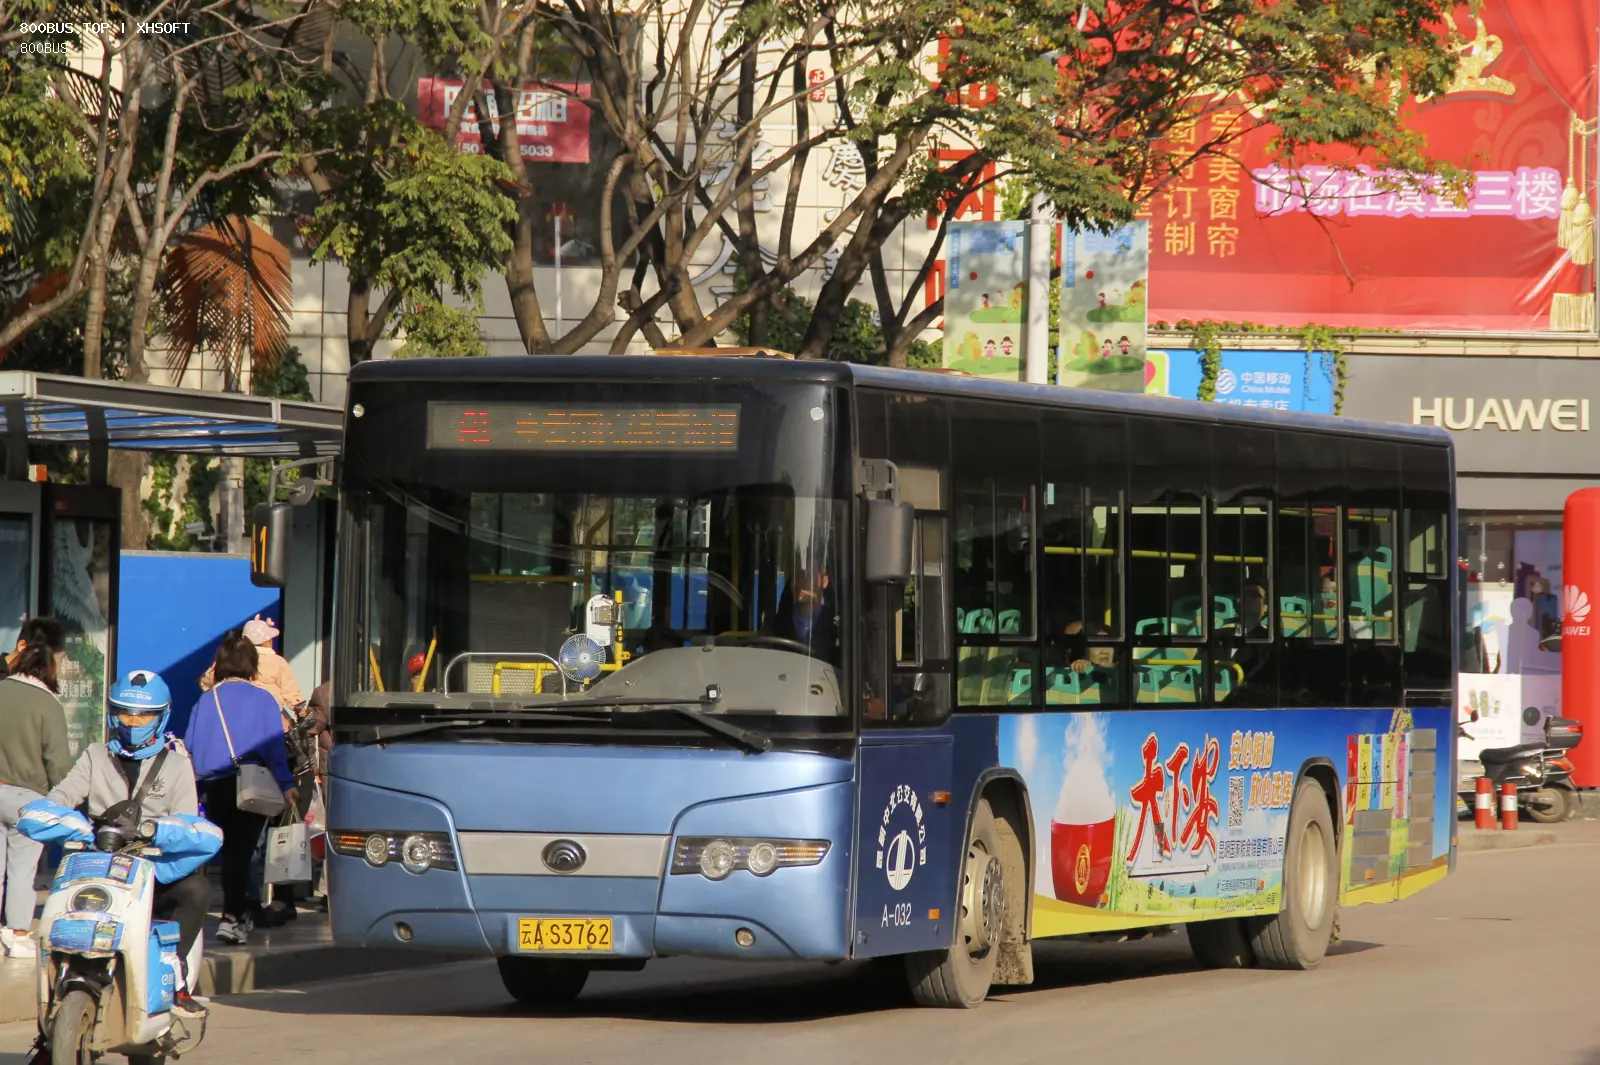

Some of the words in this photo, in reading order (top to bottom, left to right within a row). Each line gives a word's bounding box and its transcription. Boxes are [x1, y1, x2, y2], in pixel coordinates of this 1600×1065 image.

[520, 145, 553, 157] 5033
[1207, 110, 1241, 258] 完美窗帘
[1241, 371, 1291, 385] 中国移动
[1241, 385, 1264, 394] China
[1265, 386, 1291, 395] Mobile
[1412, 397, 1590, 432] HUAWEI
[1248, 770, 1294, 810] 放心选择
[881, 902, 912, 928] A-032
